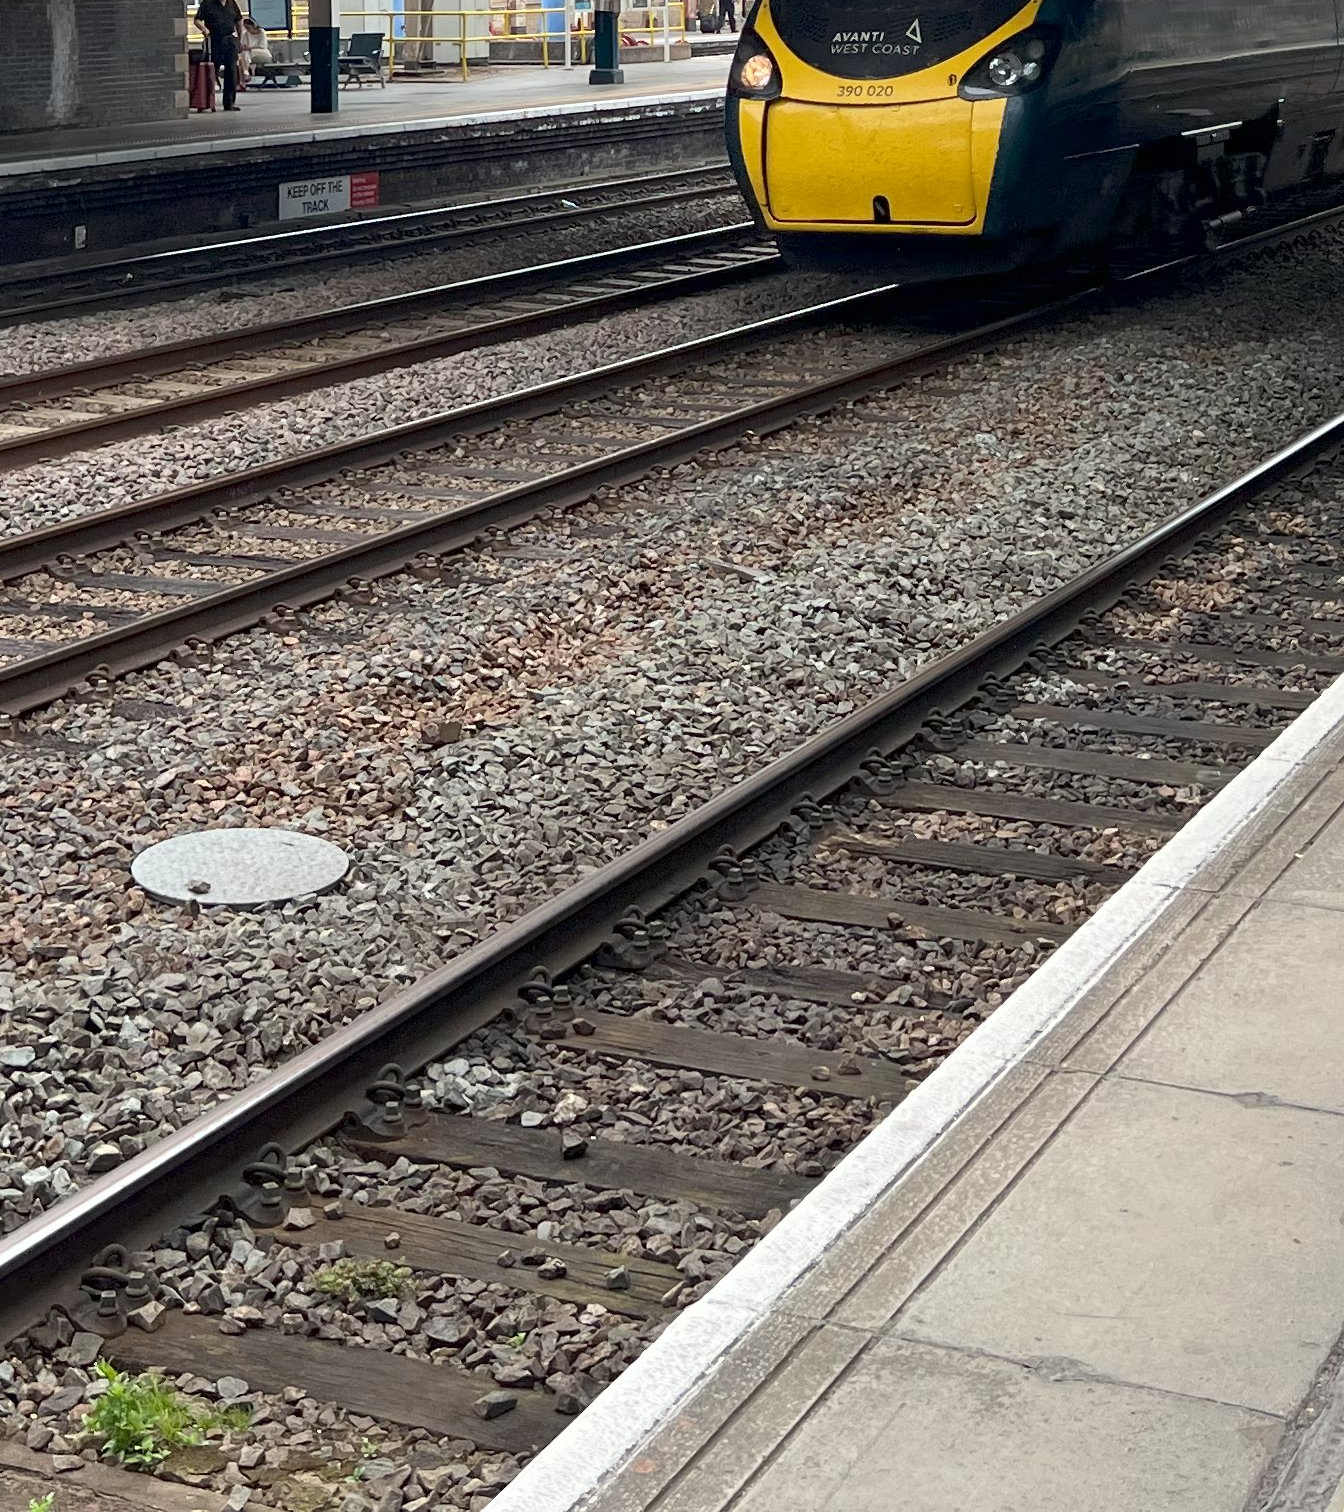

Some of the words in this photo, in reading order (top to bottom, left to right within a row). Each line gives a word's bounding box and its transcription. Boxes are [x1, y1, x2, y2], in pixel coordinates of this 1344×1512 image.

[832, 31, 885, 43] AVANTI
[830, 43, 869, 55] WEST
[871, 44, 920, 56] COAST
[837, 85, 863, 97] 390
[866, 85, 894, 97] 020
[287, 185, 309, 199] KEEP
[310, 182, 327, 196] OFF
[328, 180, 343, 193] THE
[302, 199, 330, 214] TRACK
